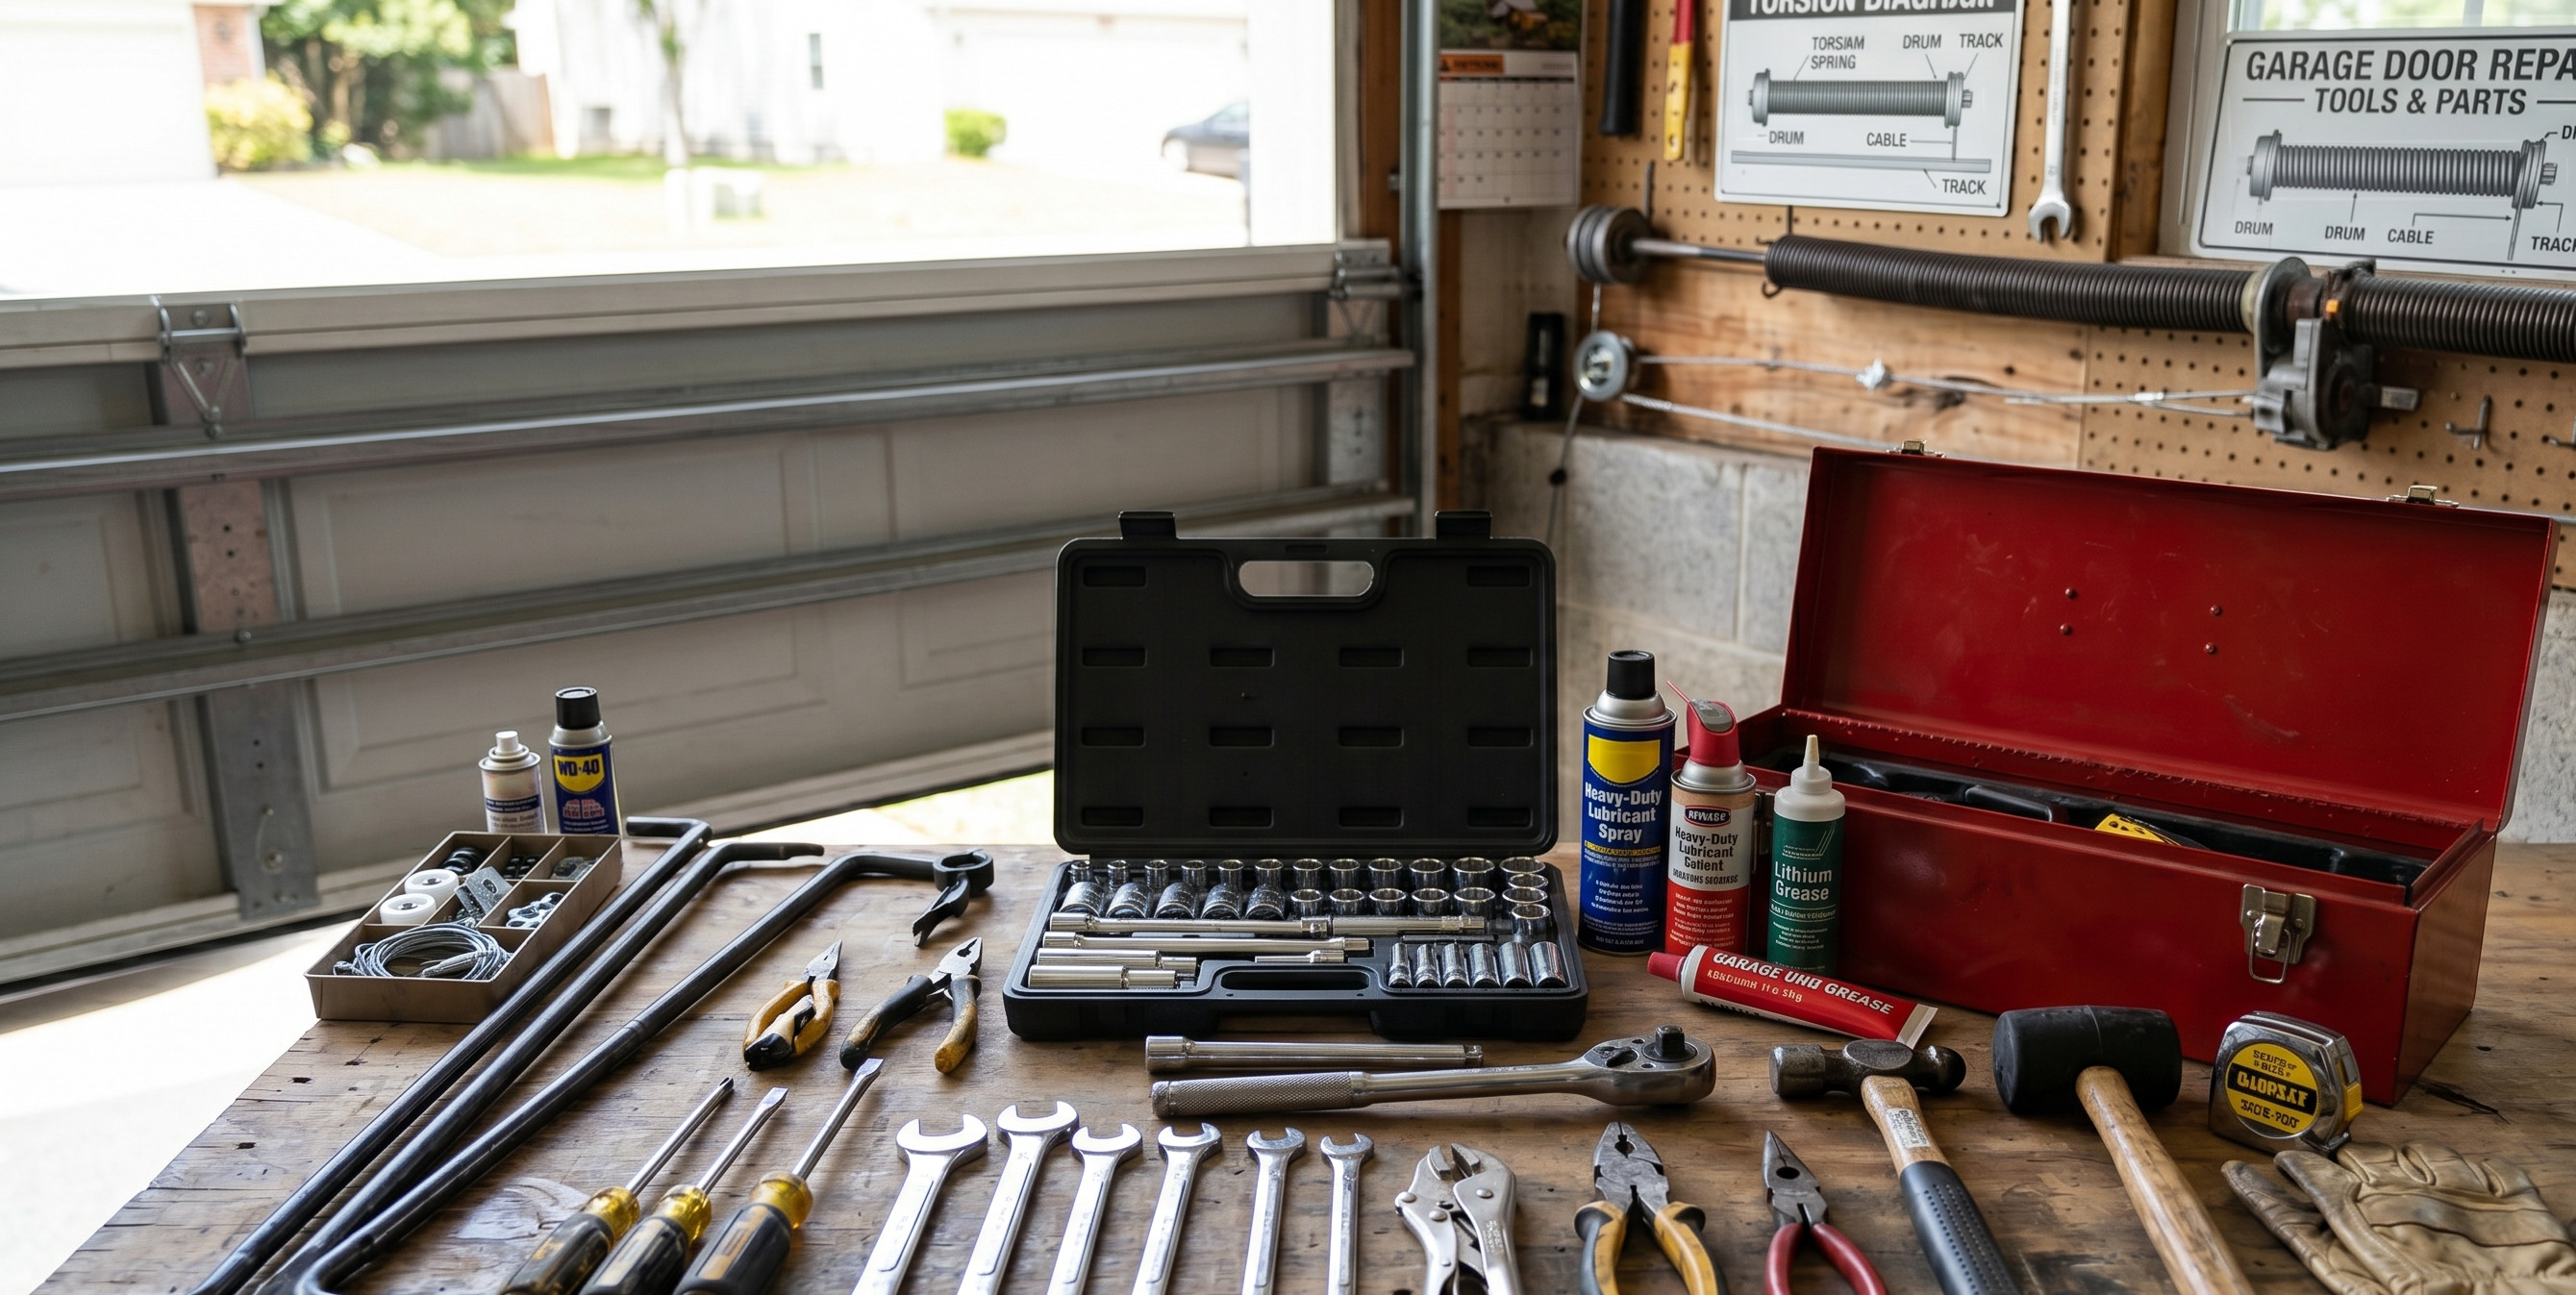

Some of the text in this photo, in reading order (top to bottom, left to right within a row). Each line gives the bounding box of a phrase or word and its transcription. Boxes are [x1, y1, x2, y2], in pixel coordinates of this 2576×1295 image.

[1903, 34, 1942, 49] DRUM
[1960, 33, 2004, 48] TRACK
[1811, 55, 1857, 70] SPRING
[2246, 50, 2375, 81] GARAGE
[2384, 49, 2479, 81] DOOR
[2314, 87, 2527, 115] TOOLS & PARTS
[1769, 131, 1805, 145] DRUM
[1866, 133, 1908, 148] CABLE
[1942, 179, 1987, 195] TRACK
[2235, 221, 2274, 236] DRUM
[2324, 226, 2366, 241] DRUM
[2388, 229, 2435, 244] CABLE
[2531, 236, 2576, 252] TRAC
[1585, 782, 1663, 808] Heavy-Duty
[1588, 802, 1657, 824] Lubricant
[1598, 823, 1642, 844] Spray
[1675, 826, 1738, 846] Heavy-Duty
[1679, 840, 1735, 859] Lubricant
[1774, 860, 1833, 884] Lithium
[1775, 879, 1830, 901] Grease
[1713, 953, 1784, 980] GARAGE
[1824, 983, 1894, 1014] GREASE
